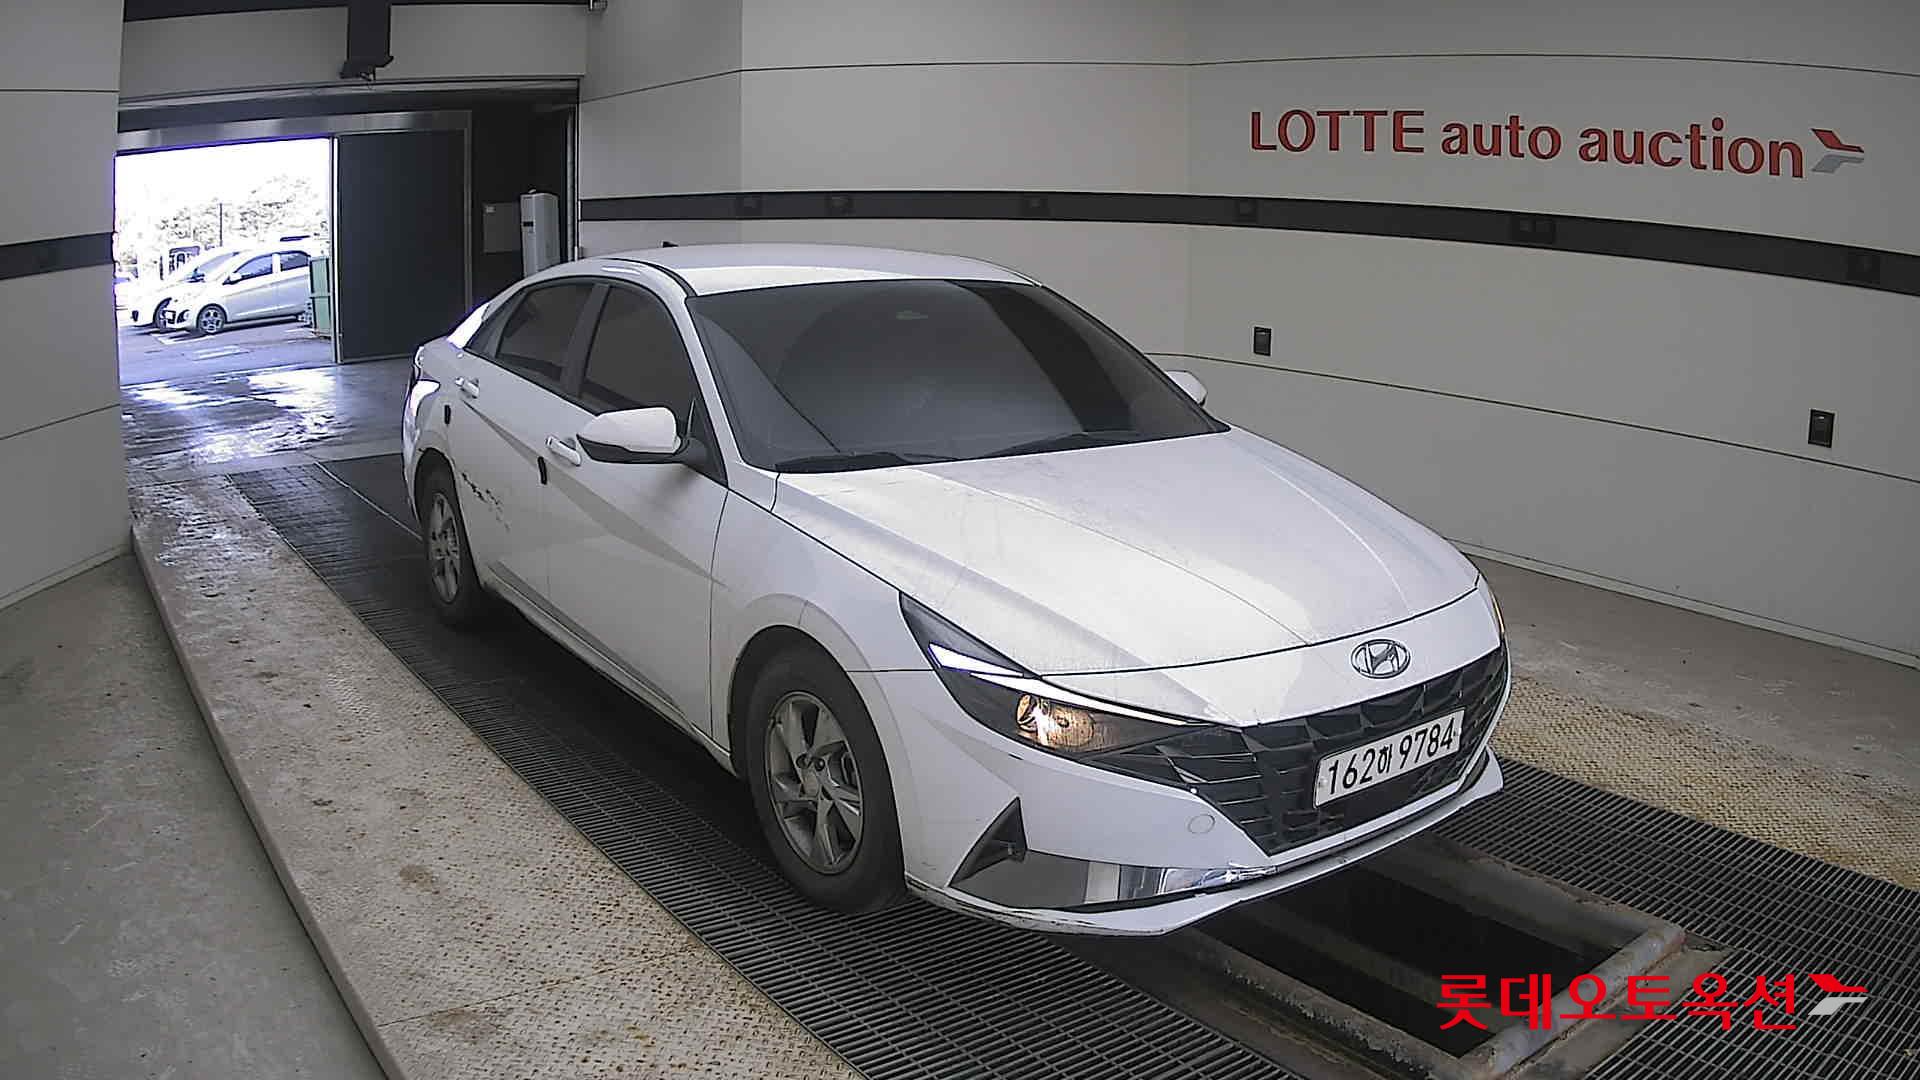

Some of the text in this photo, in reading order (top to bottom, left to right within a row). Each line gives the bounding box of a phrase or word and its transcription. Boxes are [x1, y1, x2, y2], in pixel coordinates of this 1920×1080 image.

[1250, 109, 1804, 179] LOTTE auto auction
[1399, 717, 1456, 770] 9784
